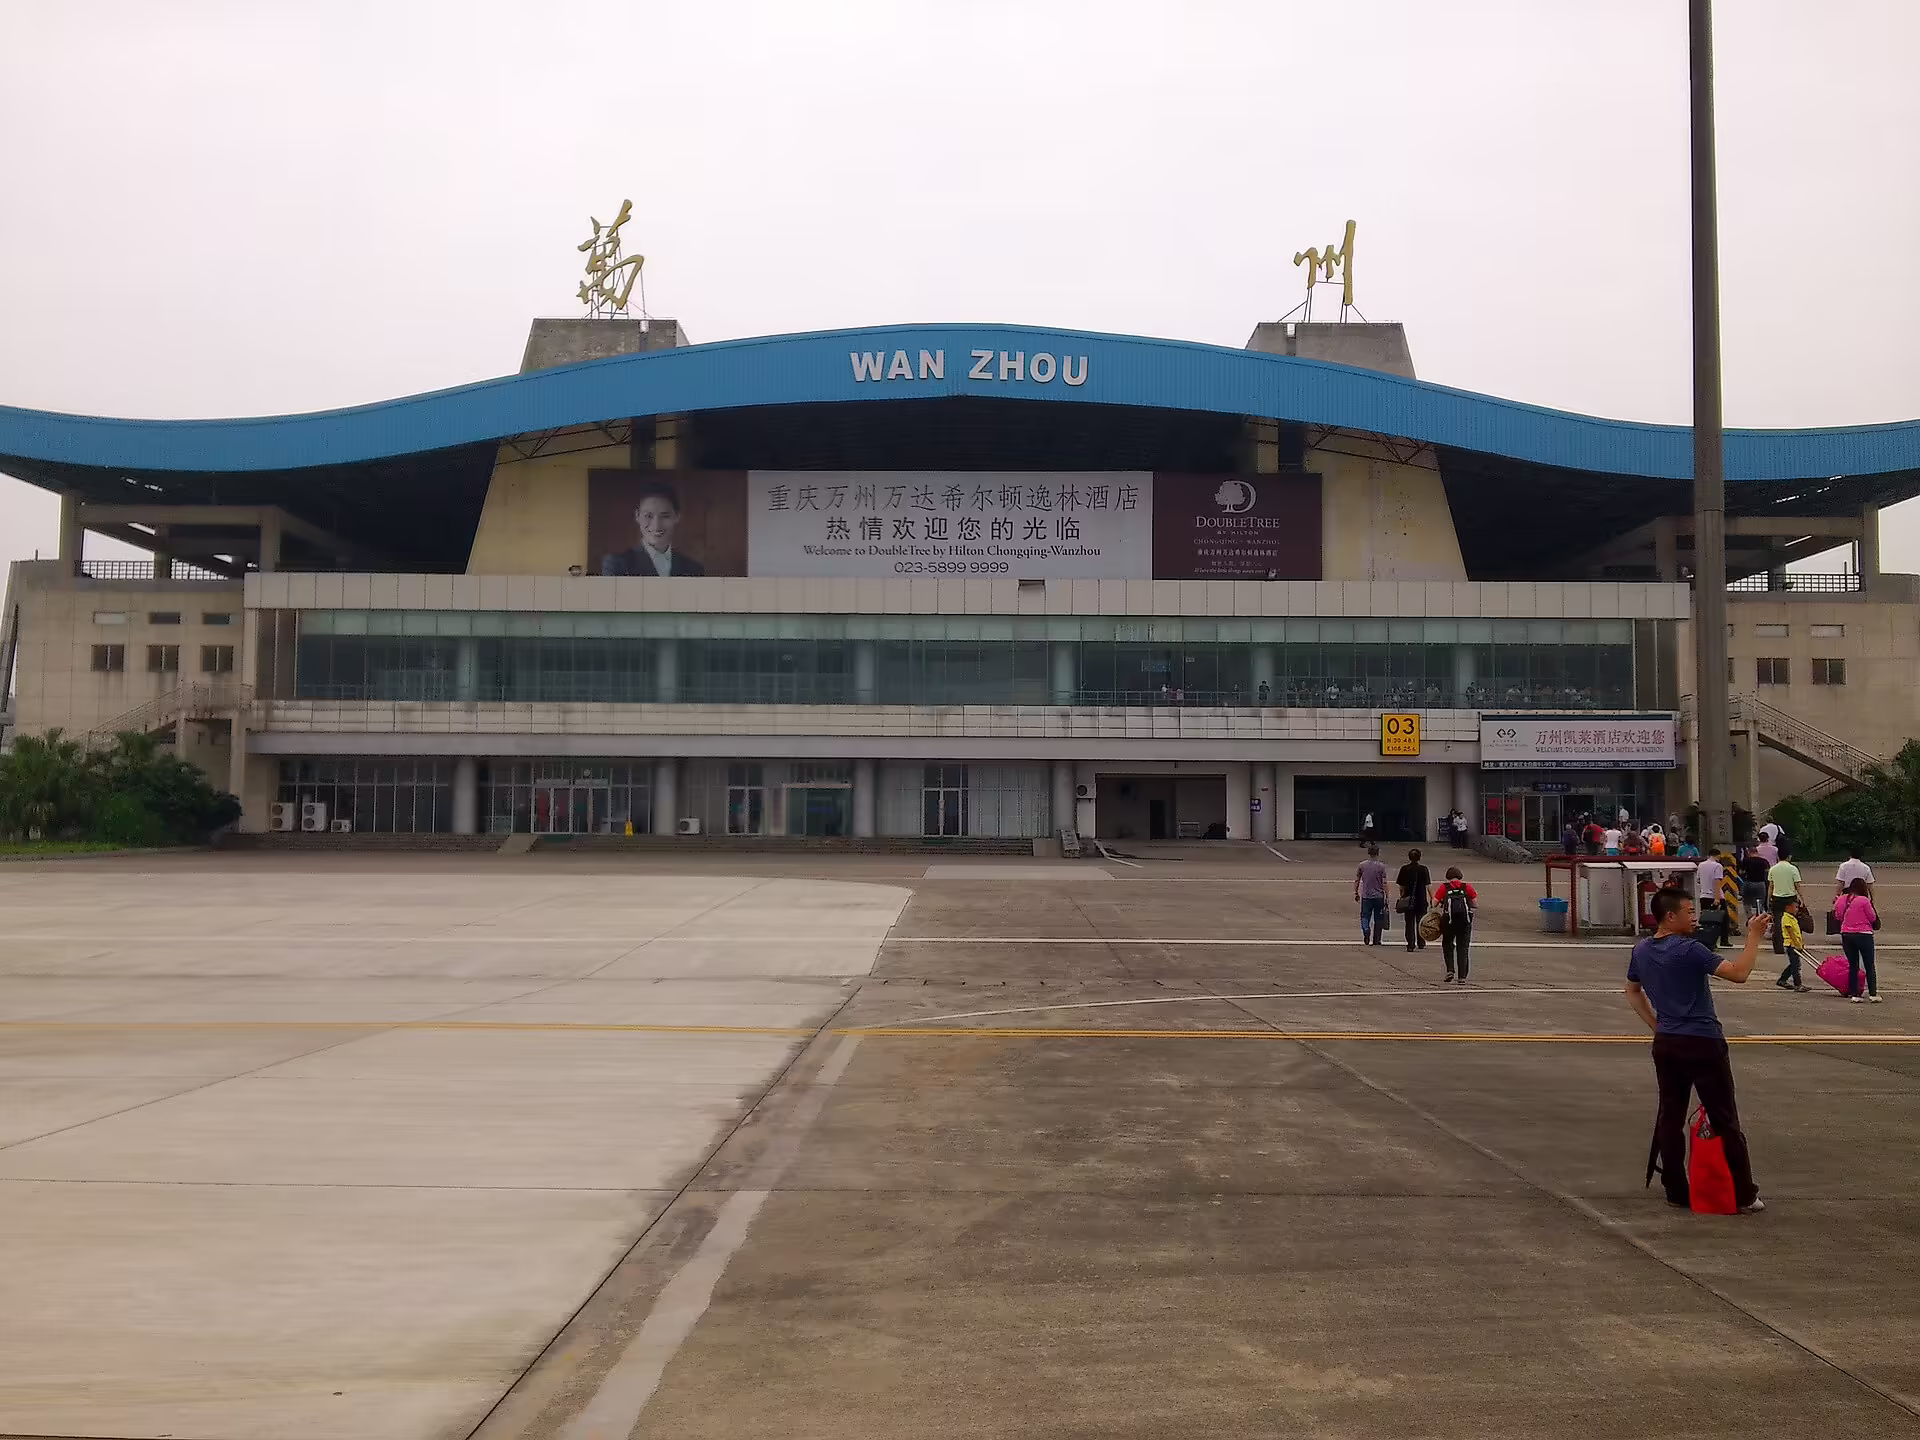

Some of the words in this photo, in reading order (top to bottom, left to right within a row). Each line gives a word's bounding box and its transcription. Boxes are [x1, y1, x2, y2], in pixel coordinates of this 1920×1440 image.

[849, 349, 945, 383] WAN
[968, 349, 1089, 387] ZHOU
[767, 483, 1139, 513] 重庆万州万达希尔顿逸林酒店
[826, 517, 1081, 541] 热情欢迎您的光临
[803, 545, 853, 556] Welcome
[855, 546, 866, 556] to
[868, 545, 931, 556] DoubleTree
[932, 545, 946, 558] by
[948, 545, 984, 556] Hilton
[986, 545, 1101, 558] Chongqing-Wanzhou
[894, 562, 968, 573] 023-5899
[970, 562, 1009, 573] 9999
[1387, 718, 1415, 735] 03
[1535, 729, 1665, 745] 万州凯莱酒店欢迎您
